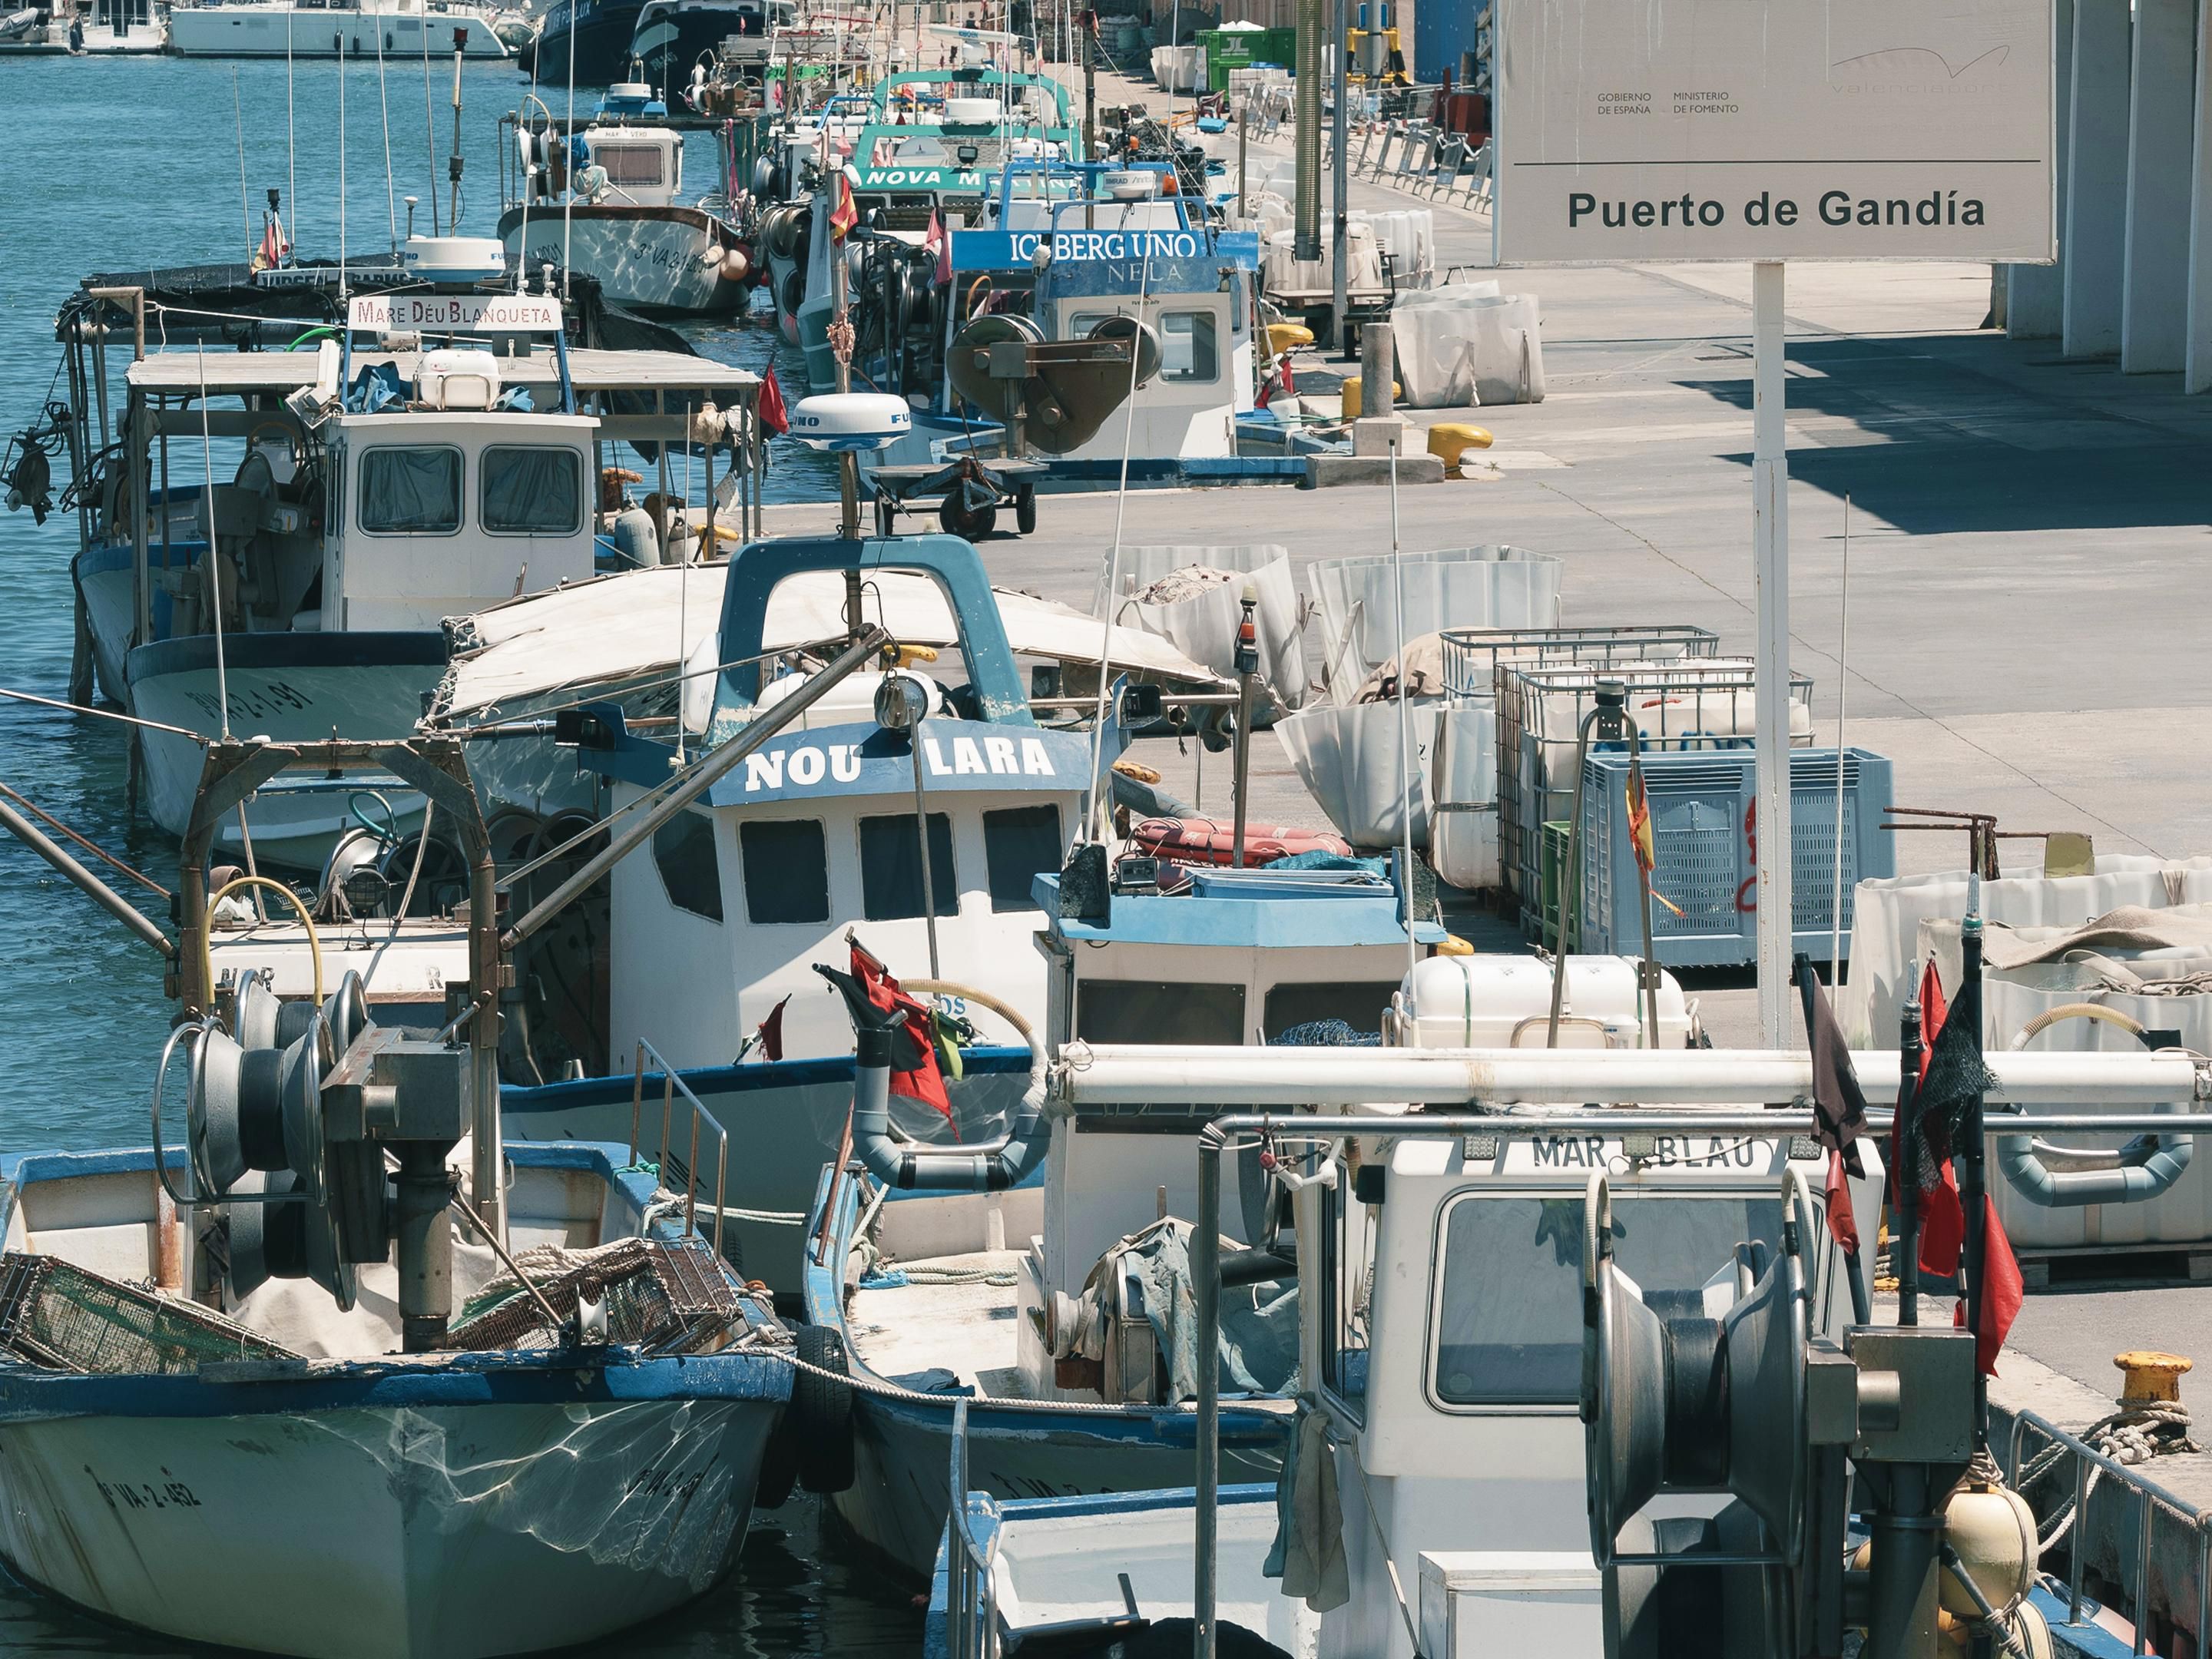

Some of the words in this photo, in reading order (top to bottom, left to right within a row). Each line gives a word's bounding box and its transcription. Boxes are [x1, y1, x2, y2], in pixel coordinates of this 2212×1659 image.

[561, 1, 591, 25] POLUX
[1598, 92, 1651, 102] GOBIERNO
[1673, 91, 1729, 101] MINISTERIO
[1598, 106, 1611, 114] DE
[1614, 104, 1651, 114] ESPAÑA
[1674, 105, 1687, 114] DE
[1689, 104, 1739, 114] FOMENTO
[866, 171, 942, 184] NOVA
[1568, 192, 1724, 227] Puerto
[1743, 191, 1799, 227] de
[1818, 190, 1985, 227] Gandía
[1009, 233, 1125, 262] ICBERG
[1131, 233, 1197, 258] UNO
[1108, 262, 1184, 284] NELA
[449, 301, 552, 324] BLANQUETA
[744, 744, 863, 792] NOU
[922, 737, 1056, 777] LARA
[1532, 1136, 1607, 1167] MAR
[1657, 1136, 1753, 1167] BLAU
